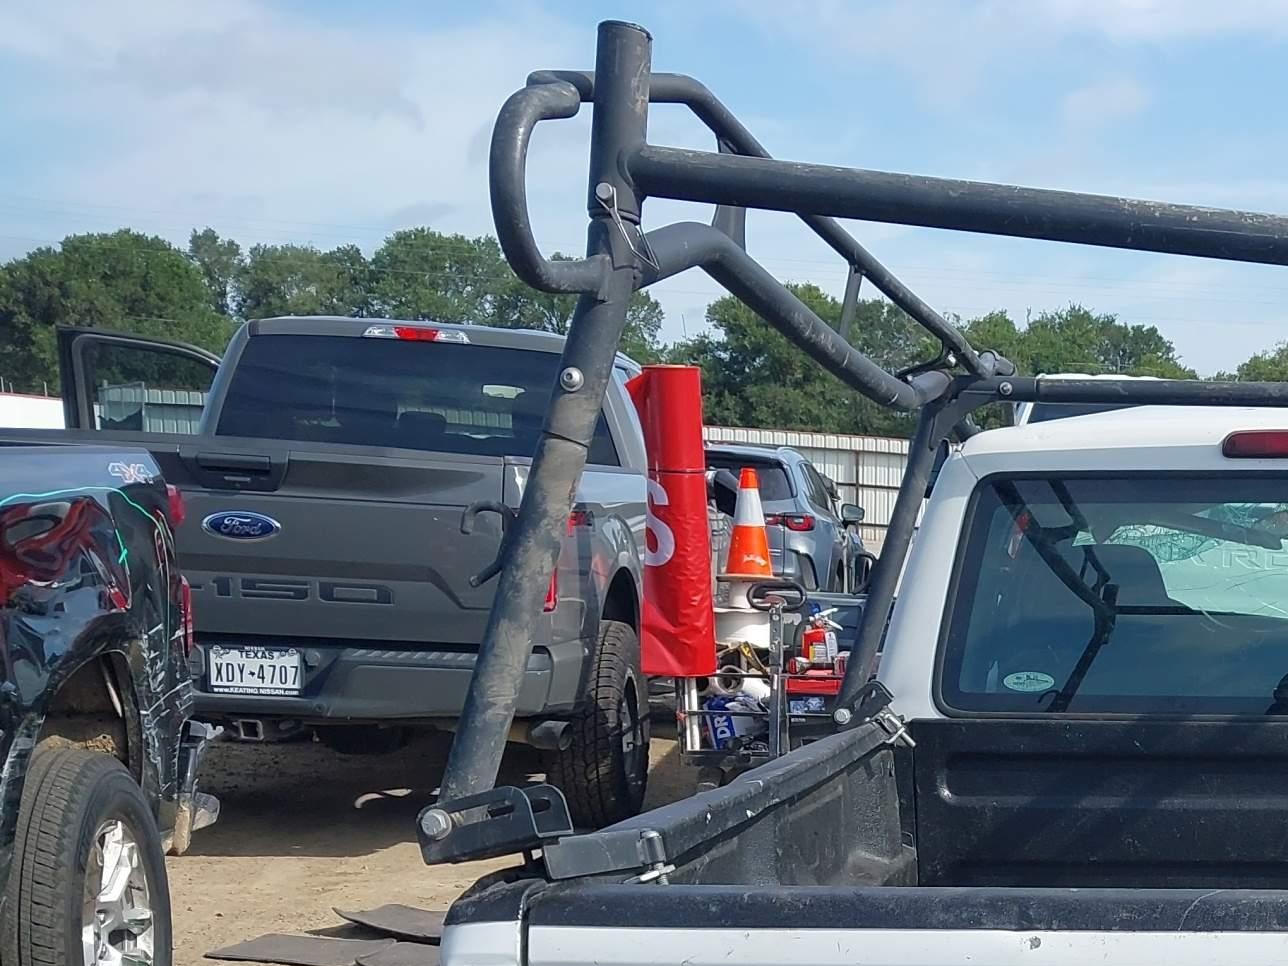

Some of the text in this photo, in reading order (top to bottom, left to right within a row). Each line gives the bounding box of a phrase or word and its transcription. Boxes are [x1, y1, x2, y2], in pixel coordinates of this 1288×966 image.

[220, 516, 263, 536] Ford
[191, 576, 393, 605] -150
[240, 651, 275, 660] TEXAS
[215, 662, 299, 685] XDY 4707
